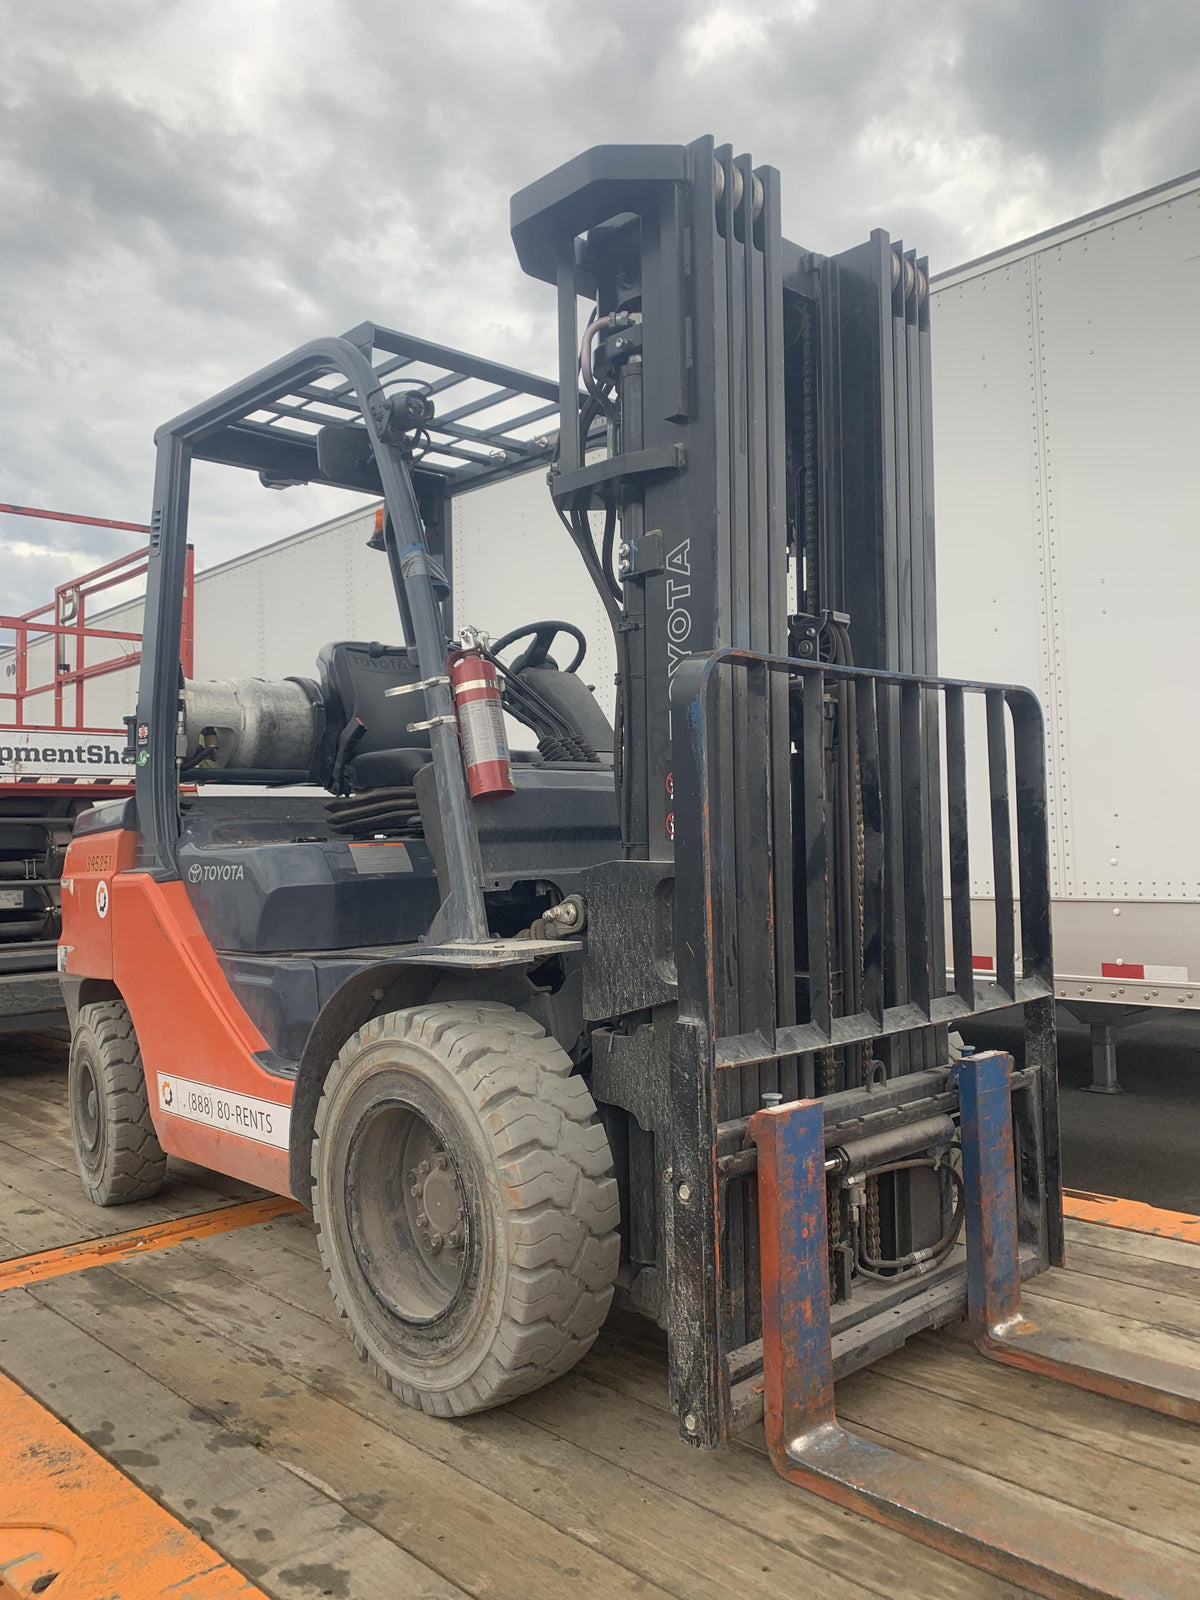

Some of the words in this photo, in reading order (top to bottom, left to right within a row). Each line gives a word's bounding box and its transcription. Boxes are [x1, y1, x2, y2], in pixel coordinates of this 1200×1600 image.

[666, 537, 692, 740] YOTA
[87, 855, 112, 872] 395251
[203, 864, 244, 881] TOYOTA
[188, 1091, 214, 1118] (888)
[217, 1101, 273, 1133] 80-RENTS
